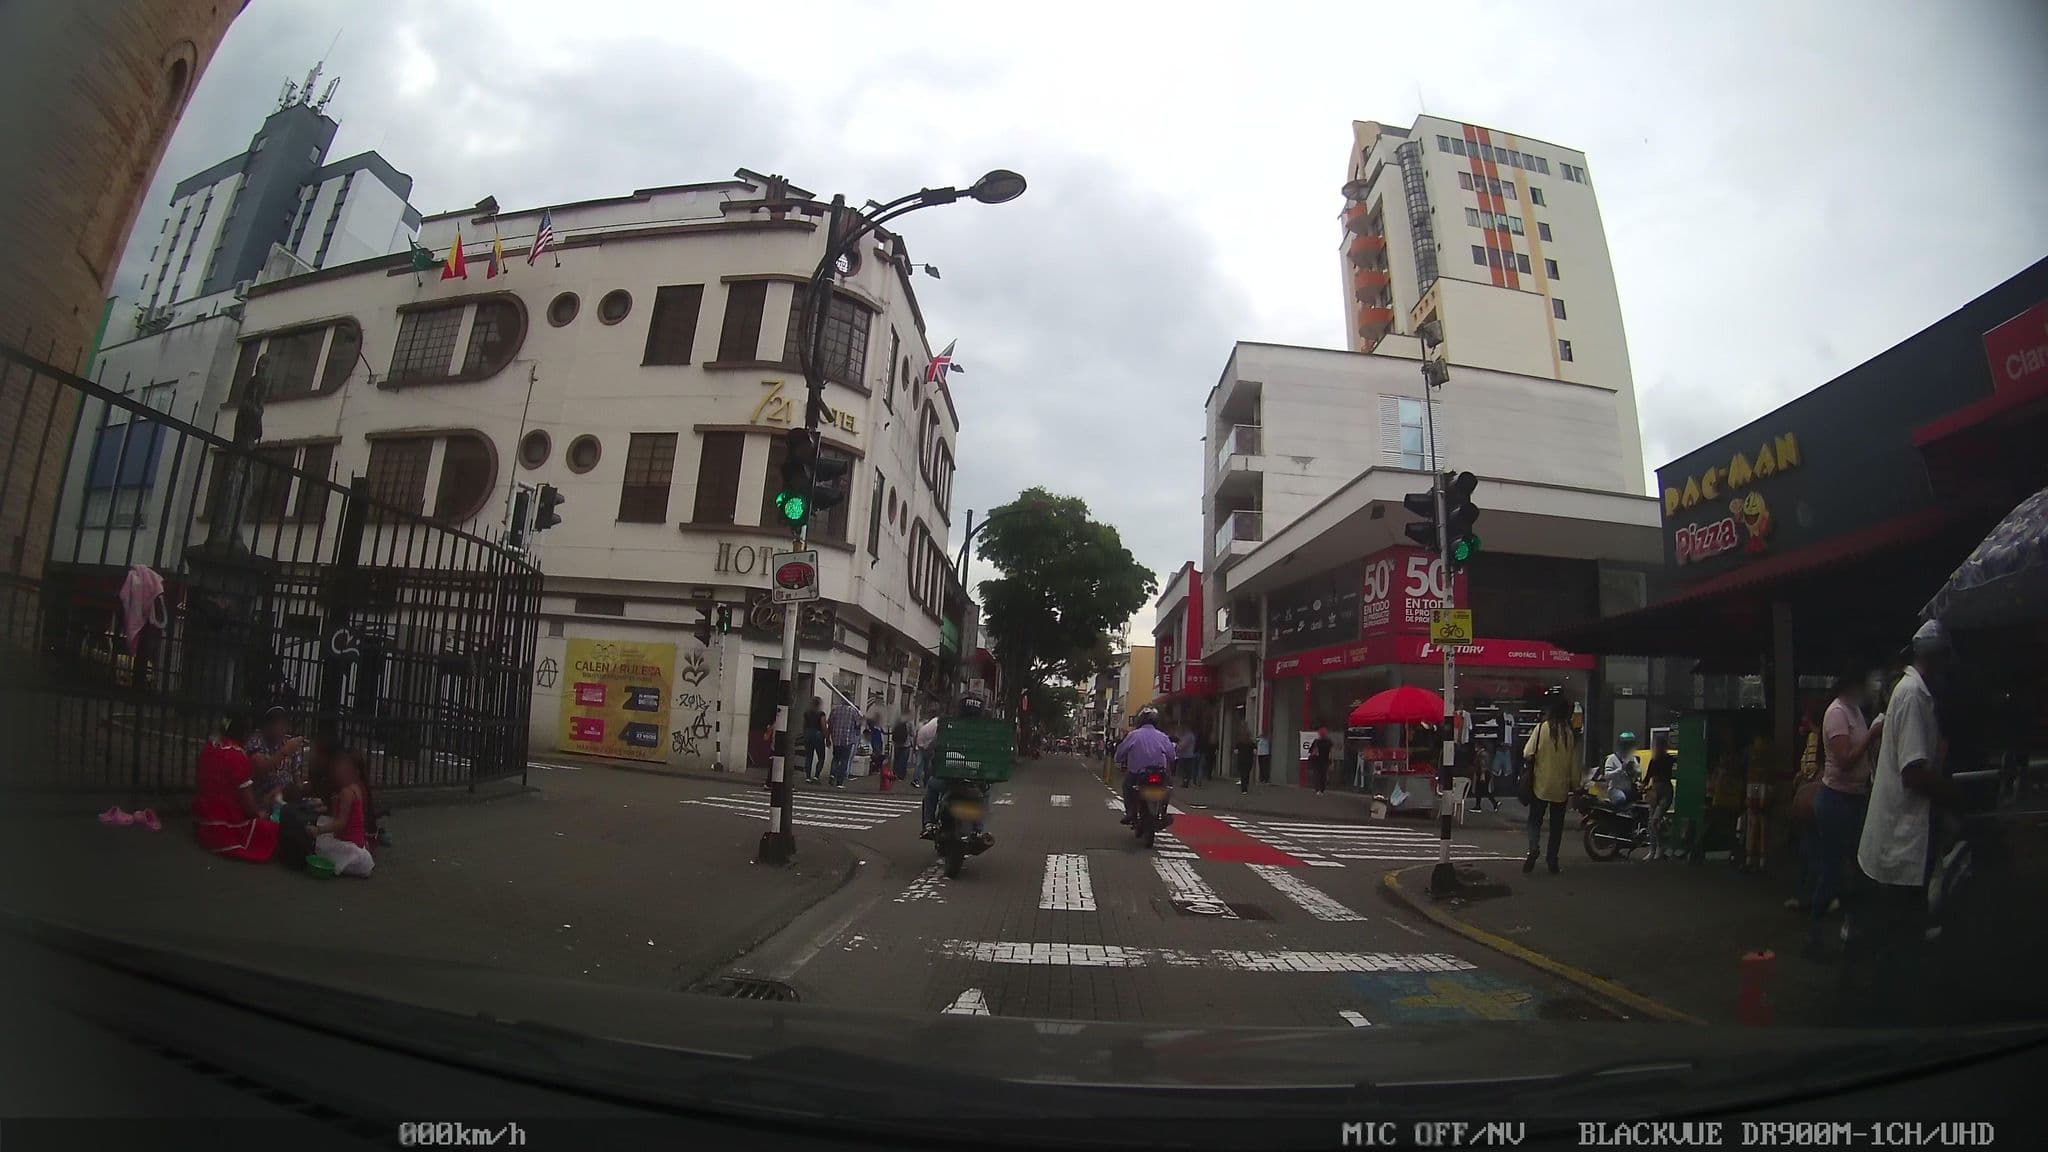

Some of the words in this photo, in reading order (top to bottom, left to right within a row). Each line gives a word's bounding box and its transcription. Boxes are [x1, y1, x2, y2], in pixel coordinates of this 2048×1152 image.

[2005, 346, 2048, 380] Clar
[750, 379, 793, 424] 721
[1664, 432, 1798, 517] PAC-MAN
[1675, 517, 1738, 565] Pizza
[1405, 597, 1421, 609] EN
[1162, 646, 1172, 691] HOTEL
